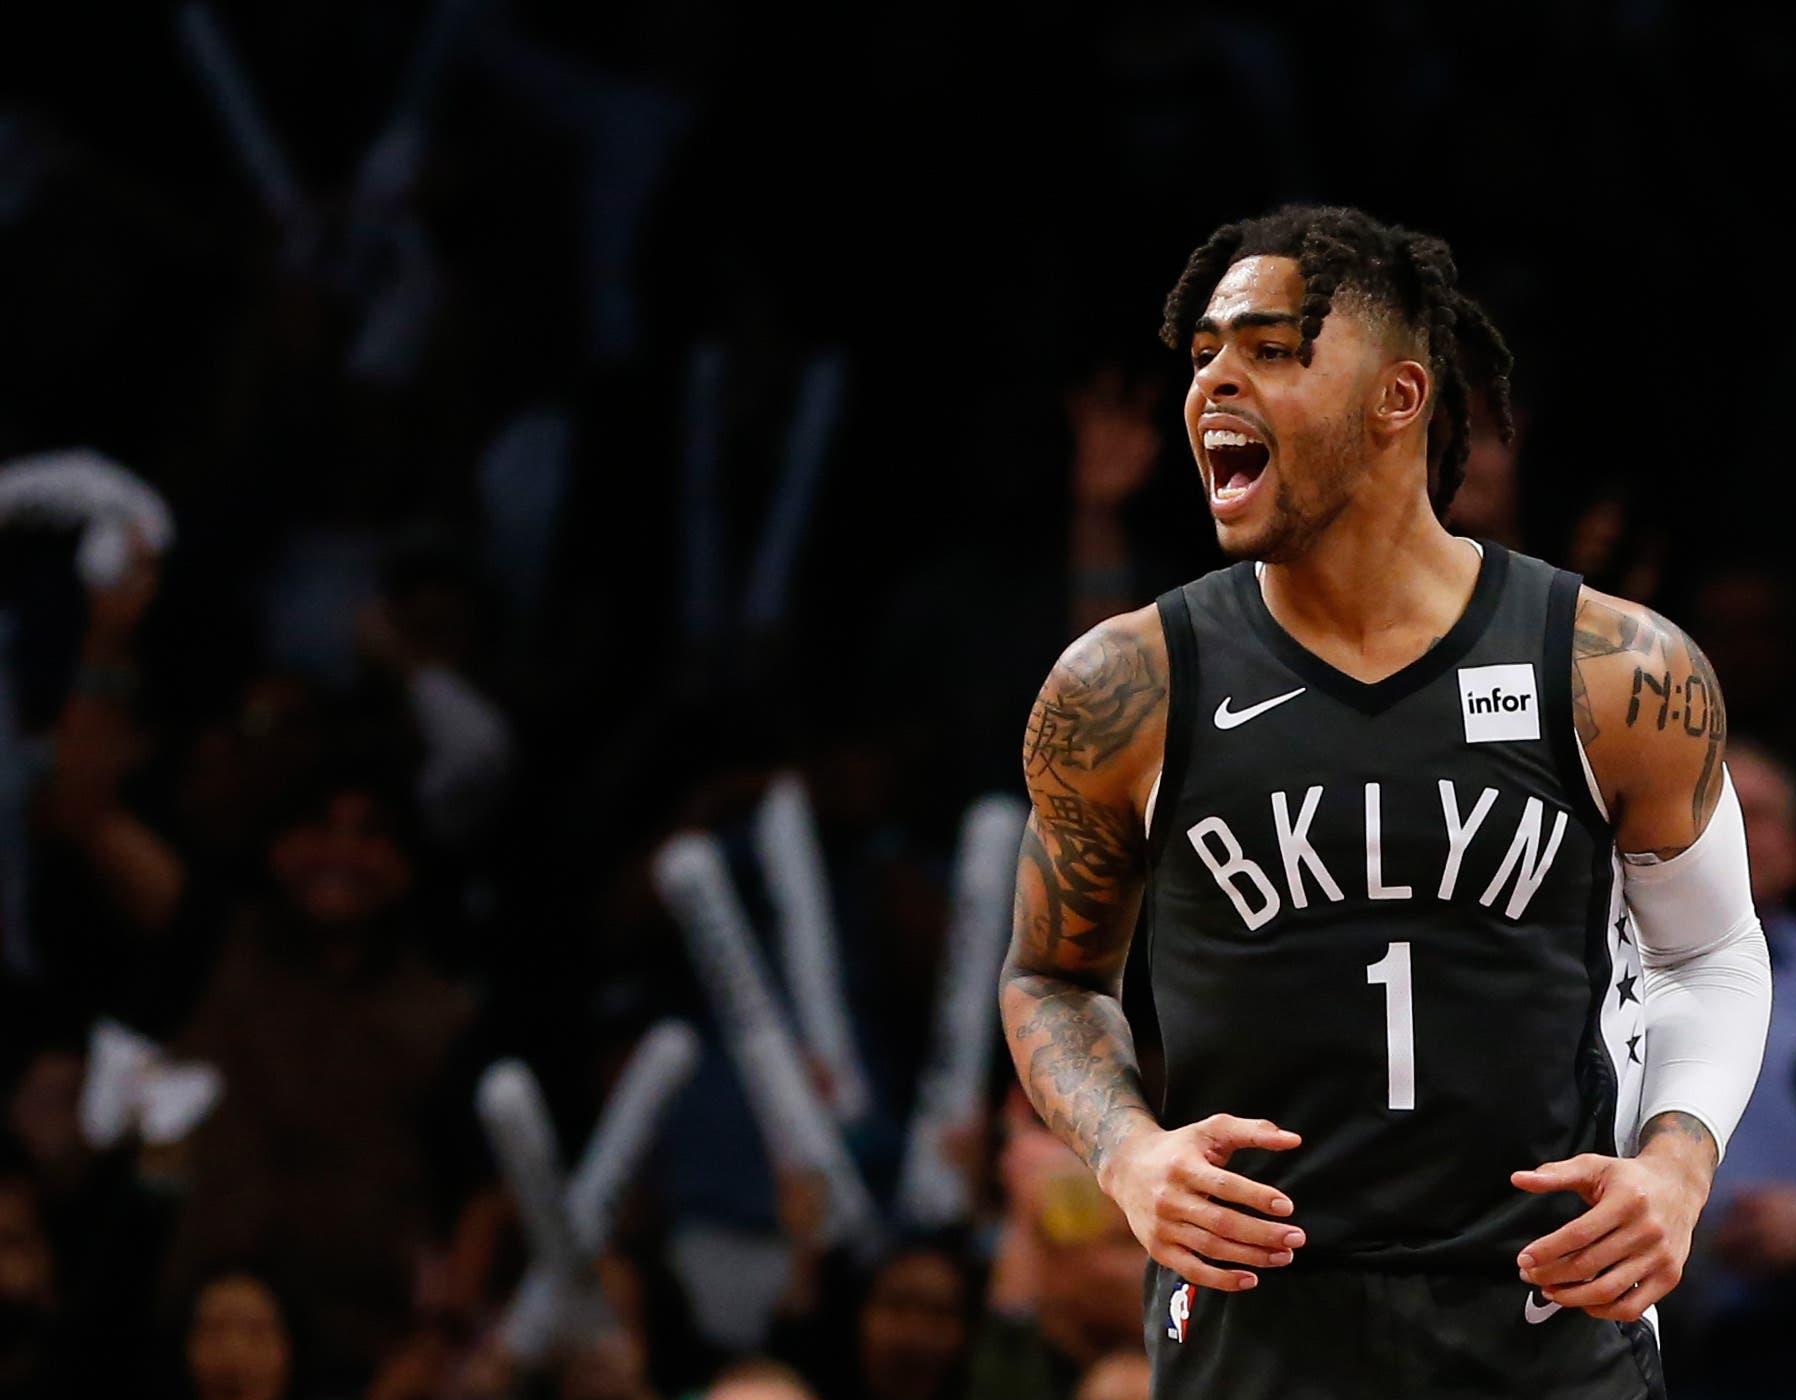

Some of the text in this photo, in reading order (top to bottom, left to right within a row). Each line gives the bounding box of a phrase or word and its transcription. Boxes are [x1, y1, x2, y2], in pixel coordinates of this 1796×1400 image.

[1466, 687, 1532, 715] infor
[1187, 779, 1568, 931] BKLYN
[1366, 942, 1415, 1110] 1
